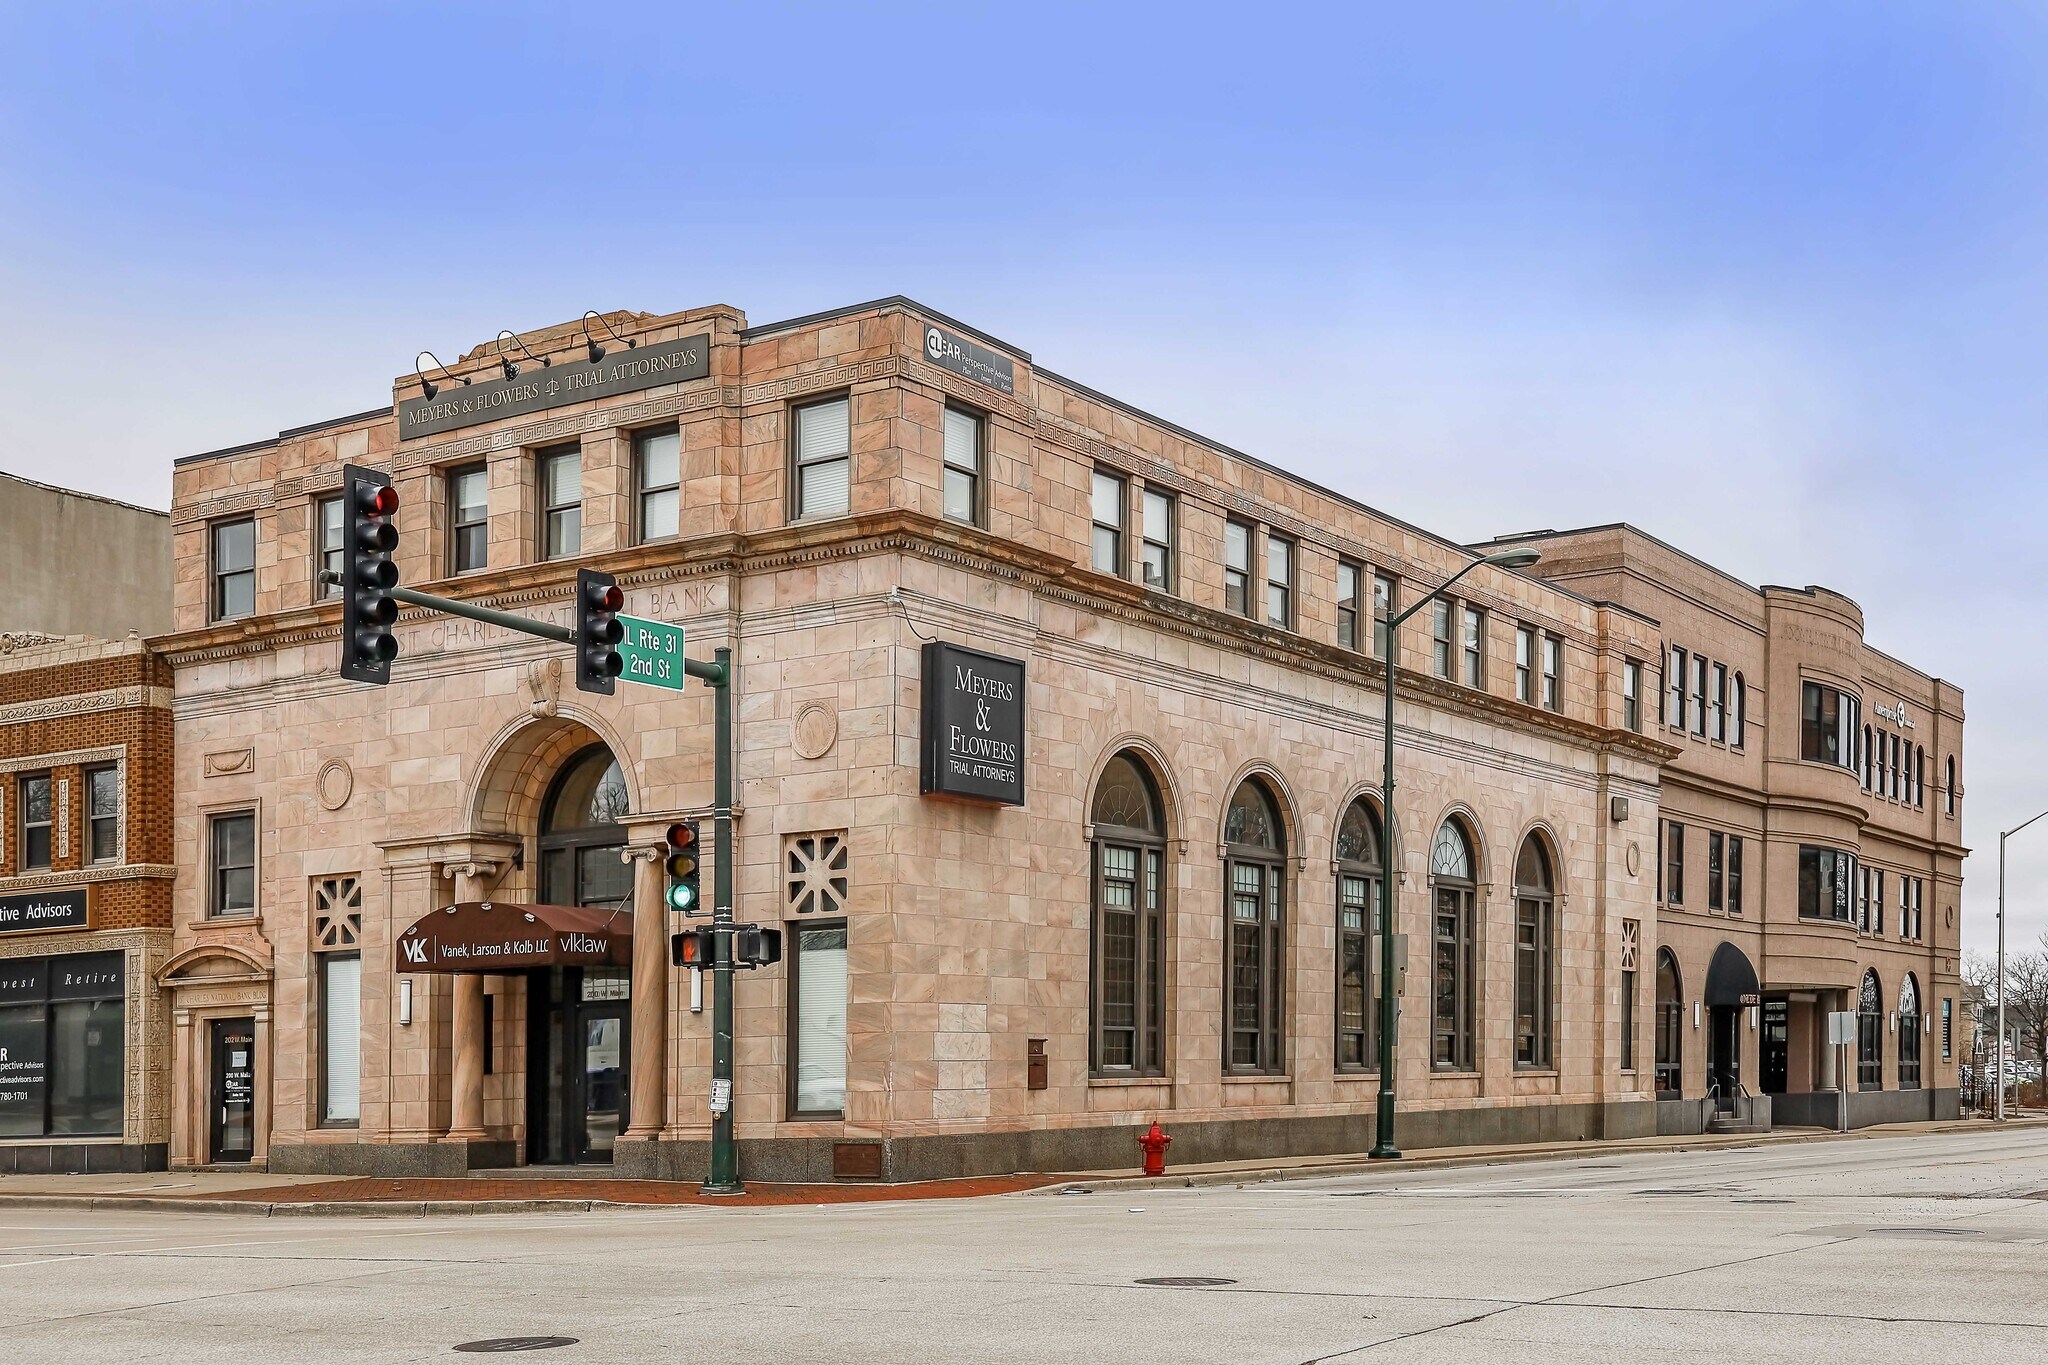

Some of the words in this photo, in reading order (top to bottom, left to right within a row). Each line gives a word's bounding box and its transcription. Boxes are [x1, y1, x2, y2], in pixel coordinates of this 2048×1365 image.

[927, 333, 961, 361] CLEAR
[961, 353, 995, 376] Perspective
[408, 400, 460, 427] MEYERS
[462, 399, 475, 413] &
[476, 382, 539, 410] FLOWERS
[565, 369, 607, 391] TRIAL
[609, 348, 698, 382] ATTORNEYS
[650, 584, 716, 615] BANK
[623, 625, 635, 646] IL
[639, 628, 660, 651] Rte
[665, 633, 677, 654] 31
[630, 653, 653, 676] 2nd
[657, 659, 671, 680] St
[975, 697, 992, 732] &
[949, 759, 971, 776] TRIAL
[972, 764, 1015, 783] ATTORNEYS
[26, 902, 72, 920] Advisors
[441, 943, 470, 958] Vanek,
[472, 943, 501, 956] Larson
[503, 941, 511, 955] &
[513, 940, 533, 954] Kolb
[535, 939, 549, 953] LLC
[560, 932, 607, 953] vlklaw
[65, 972, 117, 986] Retire
